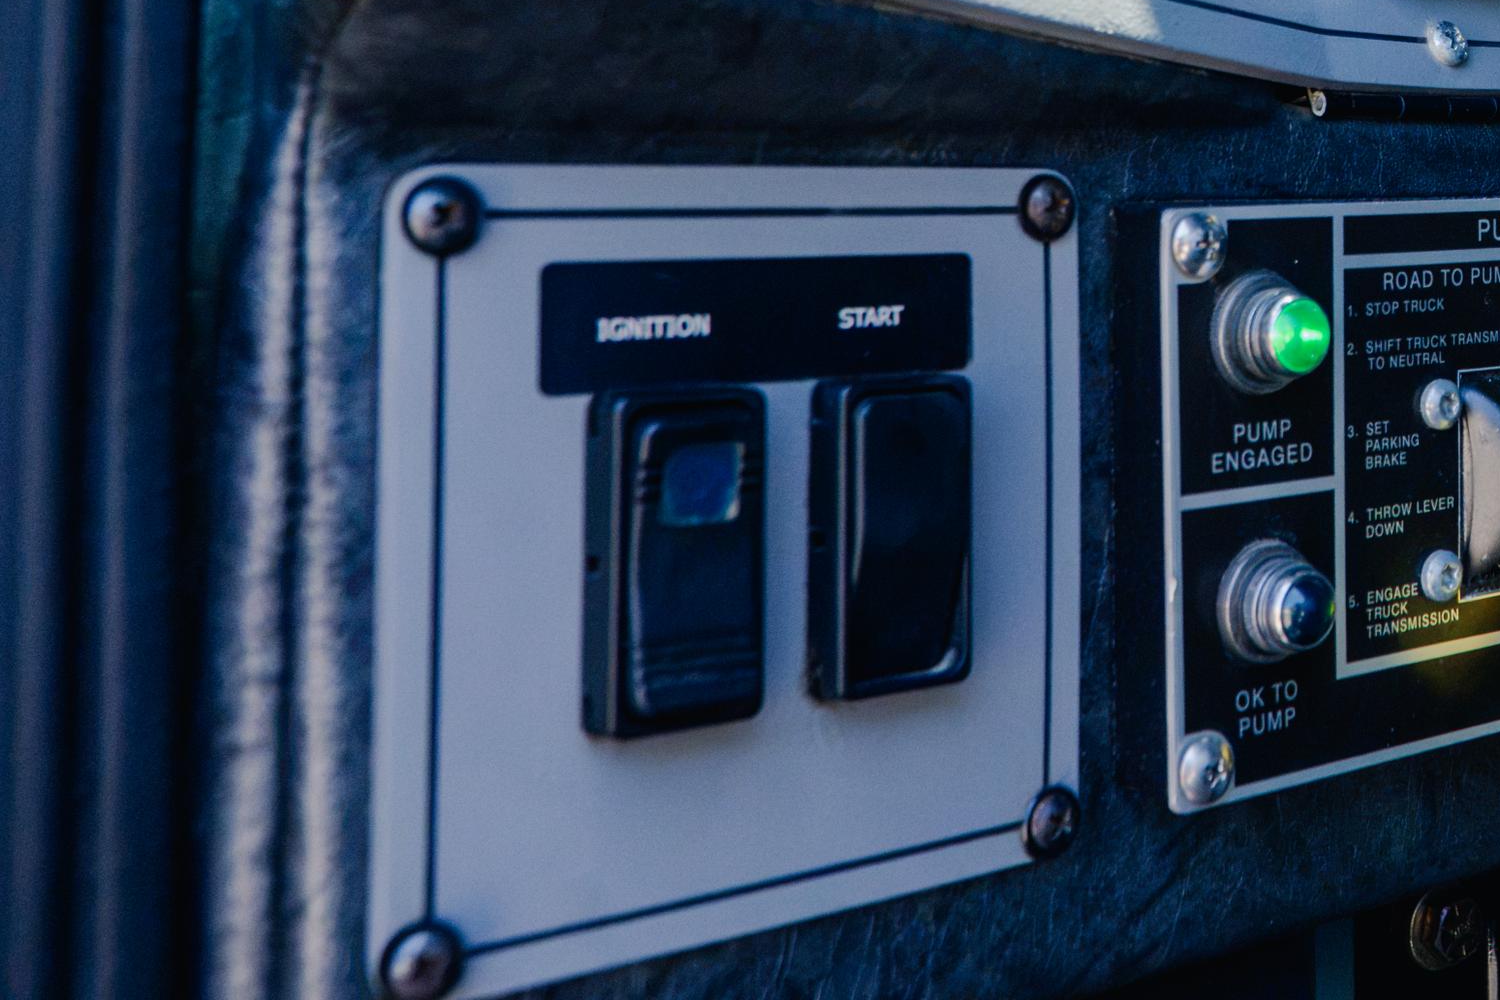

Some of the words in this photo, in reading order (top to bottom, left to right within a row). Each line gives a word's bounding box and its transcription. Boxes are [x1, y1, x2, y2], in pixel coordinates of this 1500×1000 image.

[1383, 270, 1434, 291] ROAD
[1440, 267, 1464, 287] TO
[837, 305, 904, 329] START
[1365, 300, 1400, 317] STOP
[1404, 297, 1445, 313] TRUCK
[597, 314, 712, 342] IGNITION
[1347, 343, 1358, 356] 2.
[1365, 337, 1401, 355] SHIFT
[1406, 334, 1448, 350] TRUCK
[1368, 356, 1385, 371] TO
[1389, 351, 1446, 368] NEUTRAL
[1233, 418, 1292, 444] PUMP
[1347, 425, 1359, 438] 3.
[1366, 420, 1389, 436] SET
[1366, 433, 1420, 452] PARKING
[1211, 442, 1313, 475] ENGAGED
[1365, 452, 1407, 470] BRAKE
[1366, 501, 1412, 522] THROW
[1416, 496, 1455, 514] LEVER
[1366, 520, 1404, 539] DOWN
[1367, 583, 1419, 605] ENGAGE
[1366, 601, 1409, 622] TRUCK
[1366, 608, 1460, 639] TRANSMISSION
[1235, 686, 1265, 712] OK
[1271, 680, 1298, 703] TO
[1238, 706, 1296, 739] PUMP
